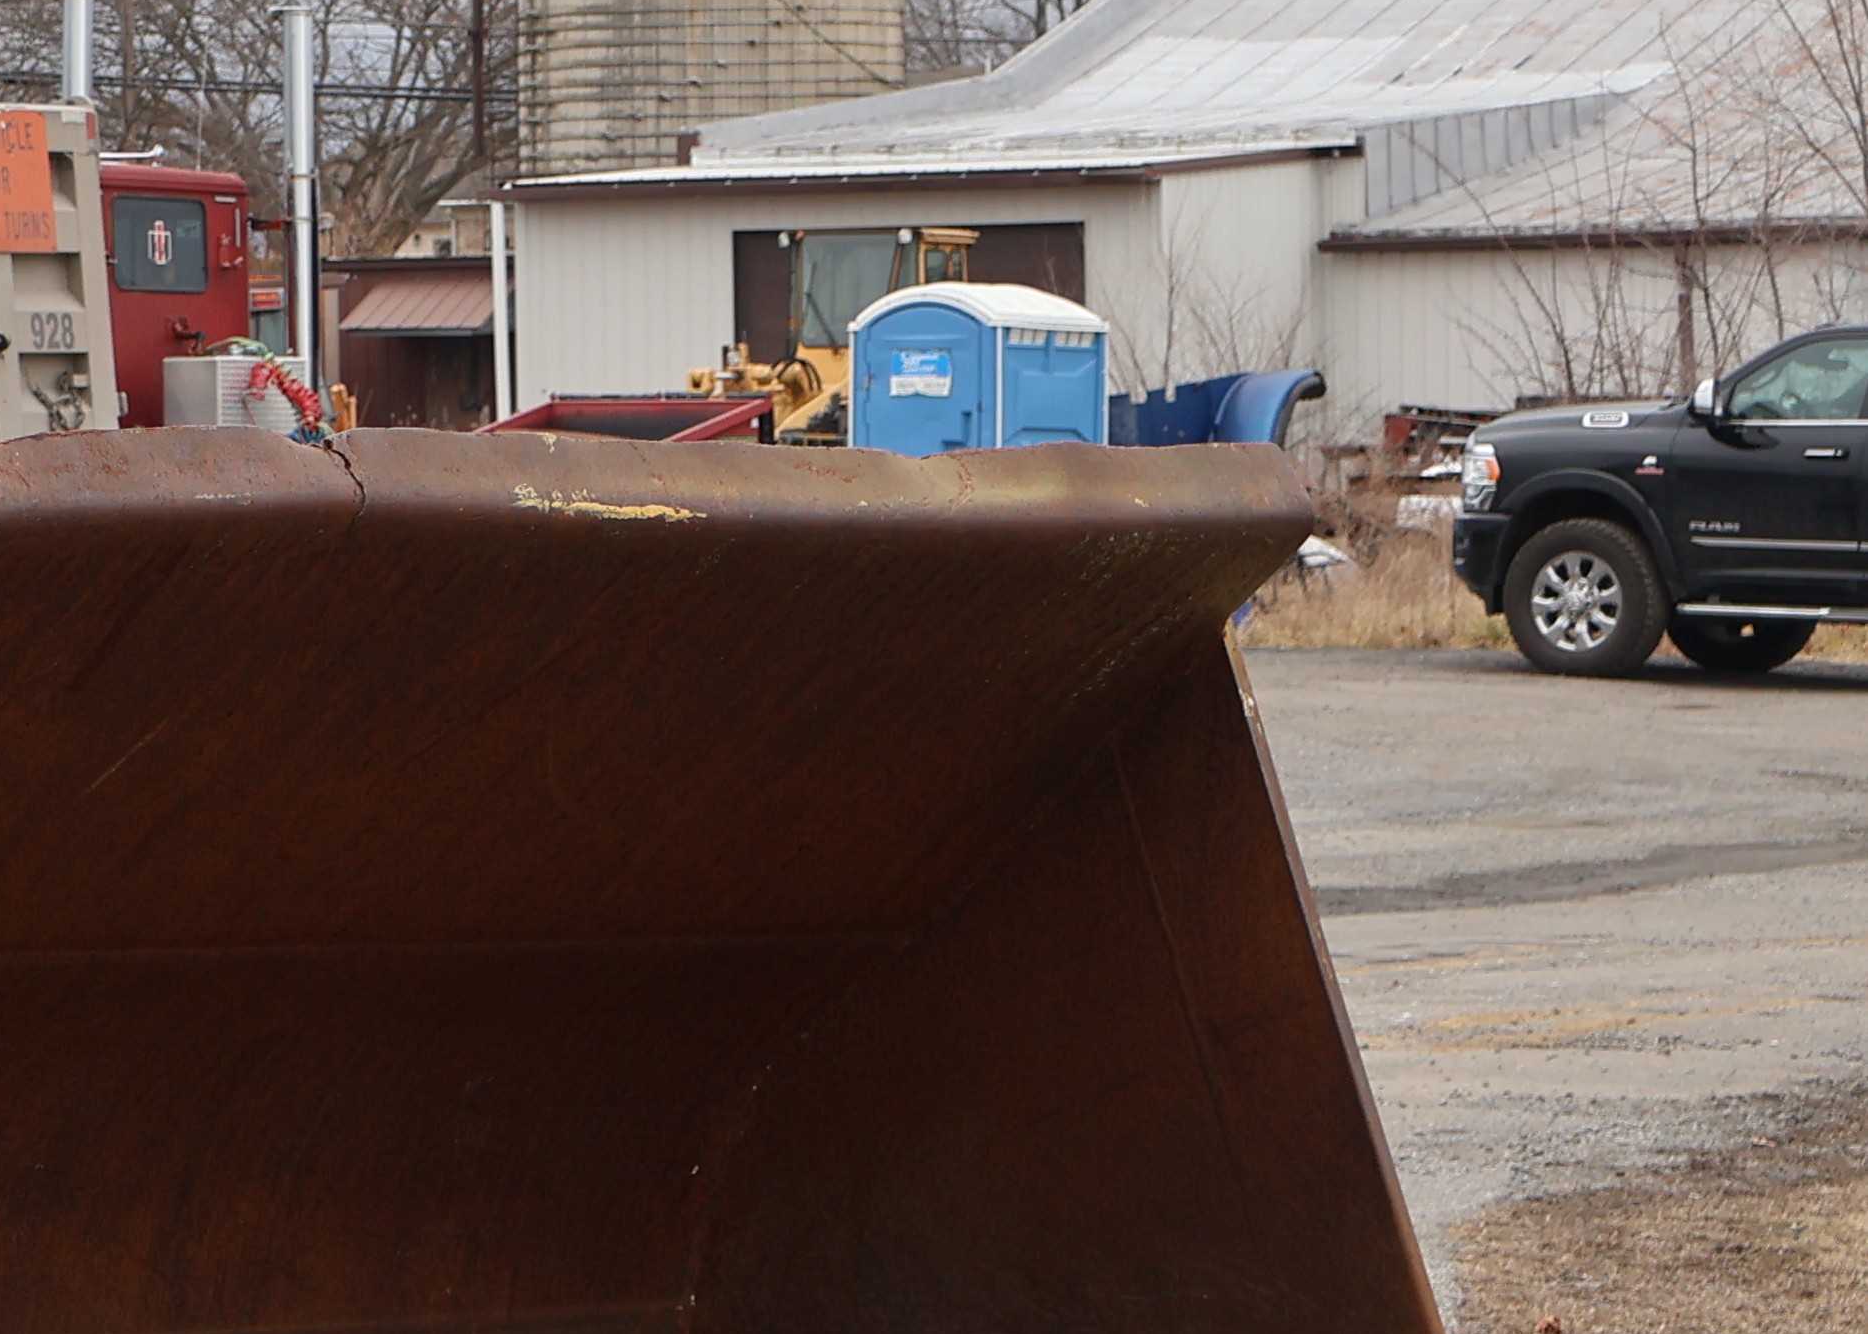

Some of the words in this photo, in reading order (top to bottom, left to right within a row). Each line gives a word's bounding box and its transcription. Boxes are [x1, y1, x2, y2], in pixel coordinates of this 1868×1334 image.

[3, 210, 51, 240] TURNS
[31, 312, 74, 349] 928
[1689, 520, 1740, 533] RAM
